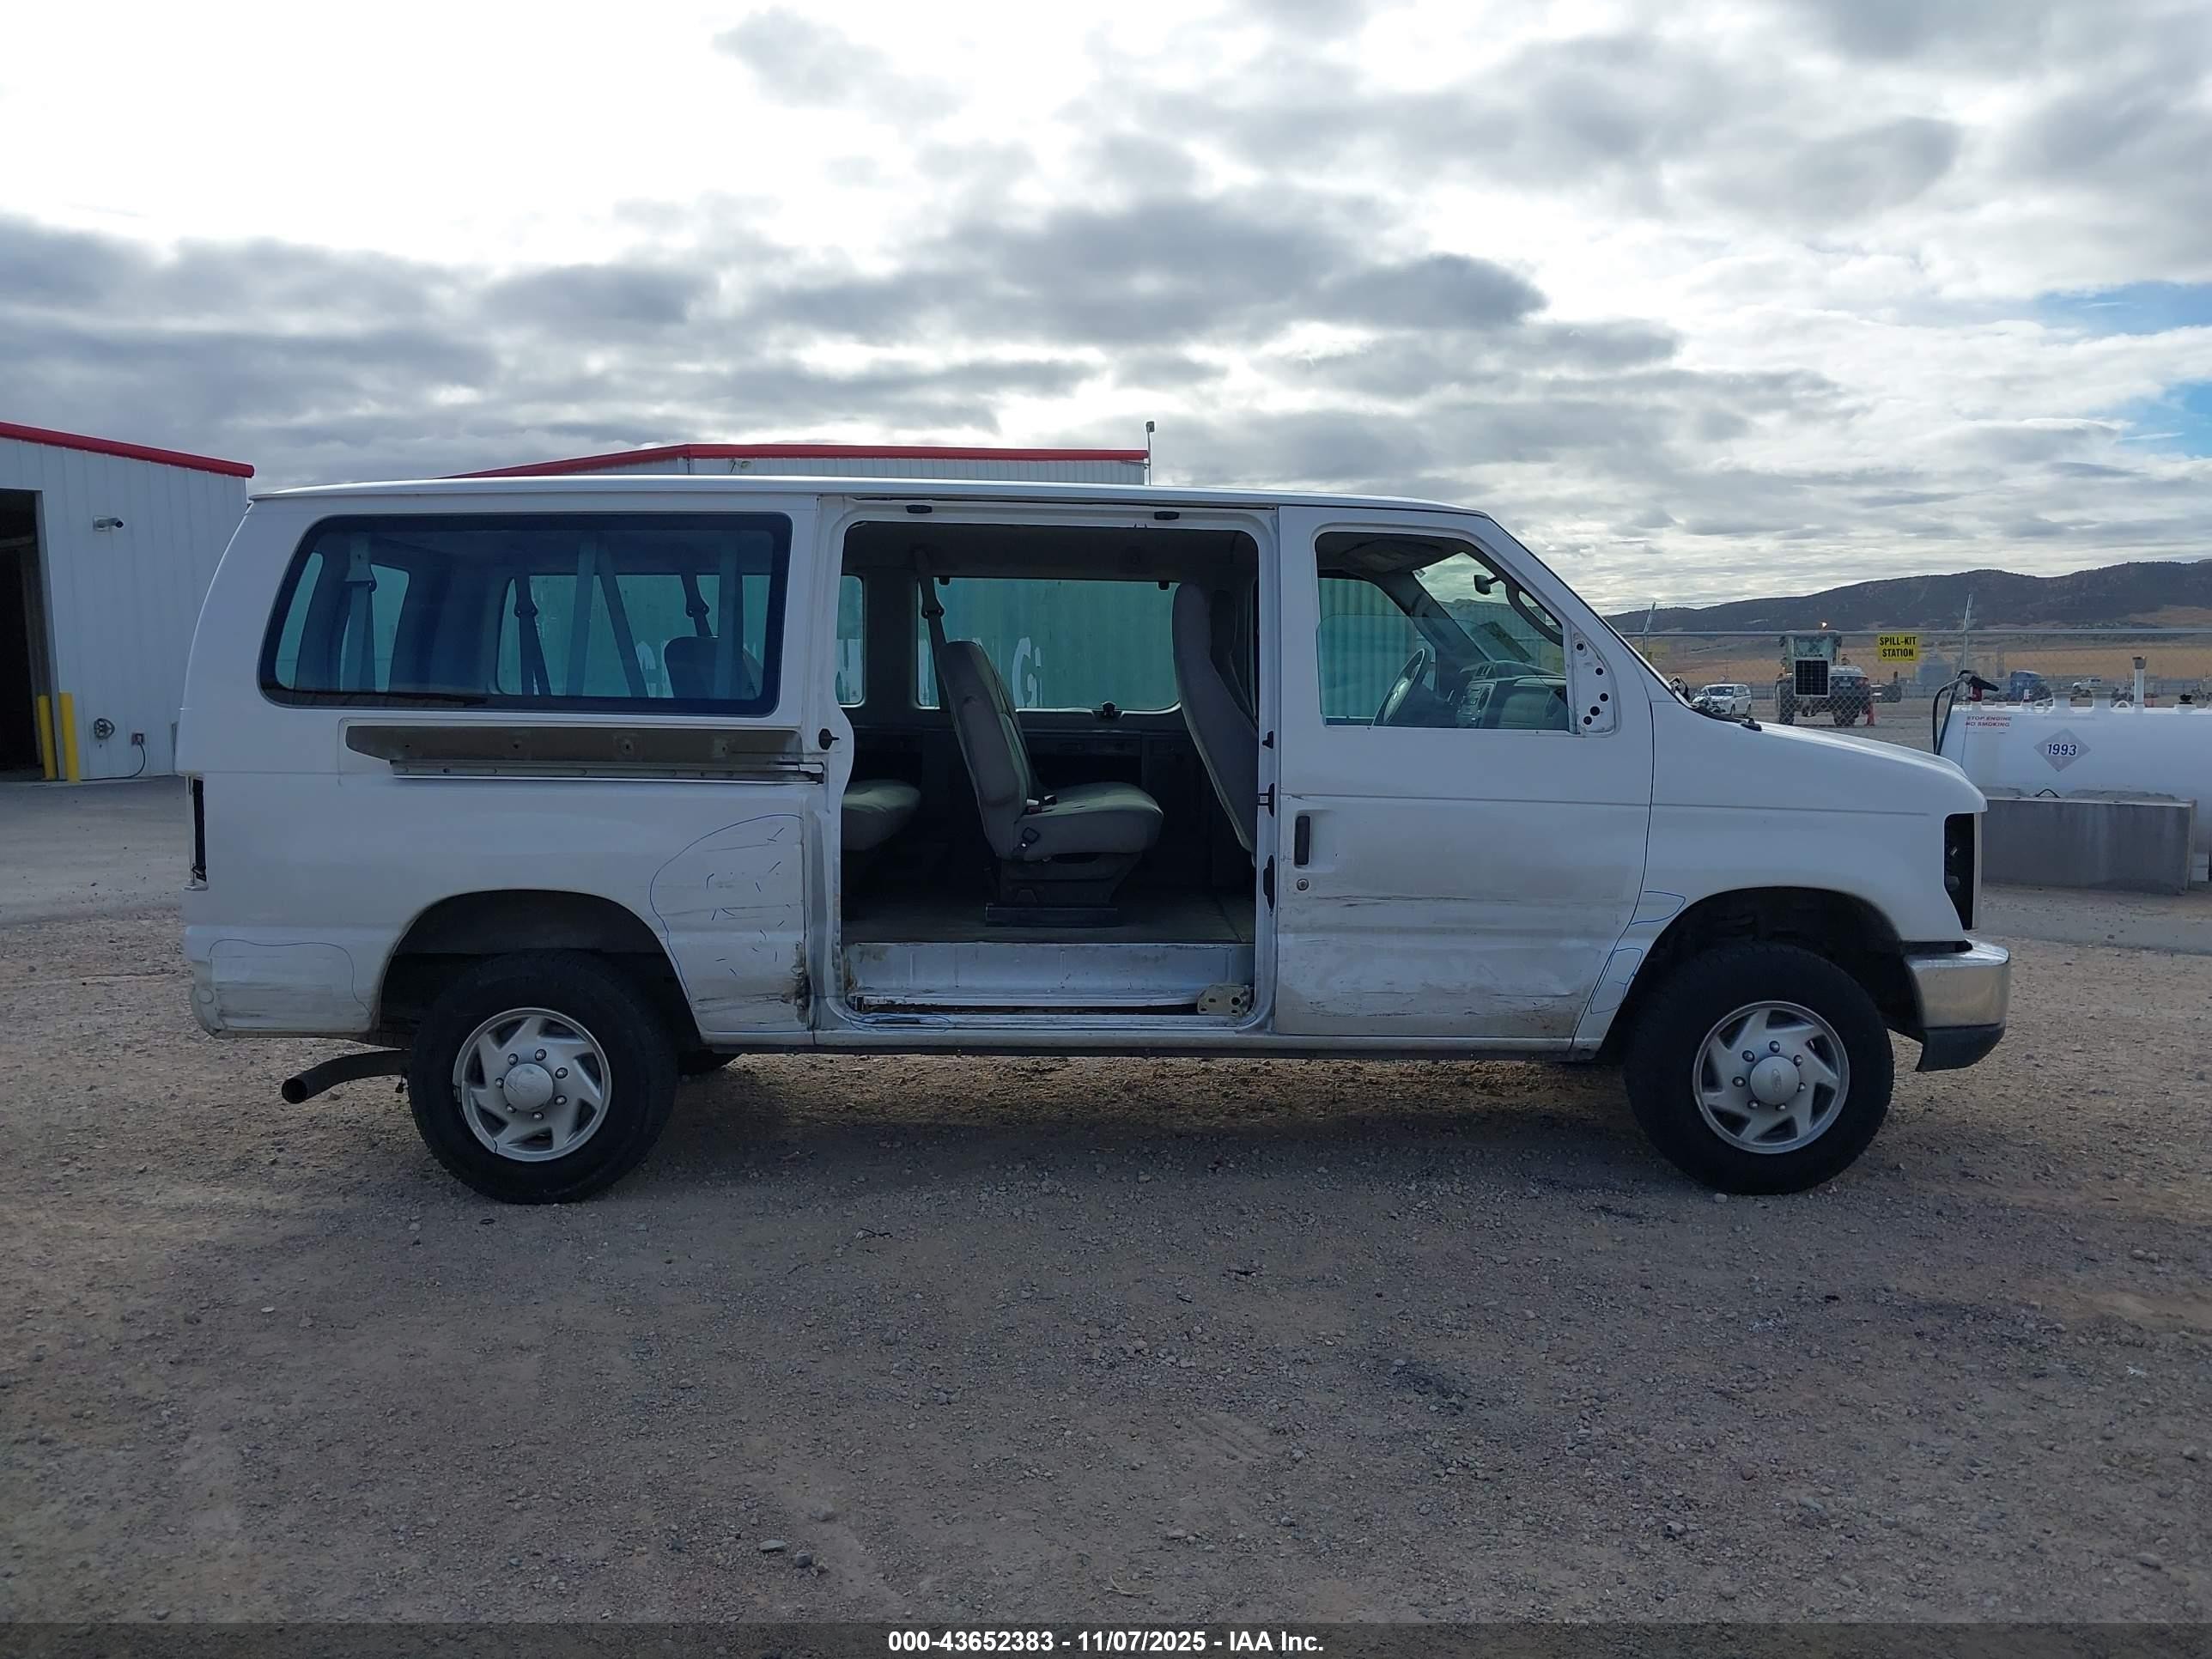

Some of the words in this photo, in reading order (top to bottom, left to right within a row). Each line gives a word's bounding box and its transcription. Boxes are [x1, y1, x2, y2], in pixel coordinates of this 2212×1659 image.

[1879, 636, 1917, 646] SPILL-KIT
[1882, 647, 1914, 658] STATION
[2047, 744, 2077, 756] 1993
